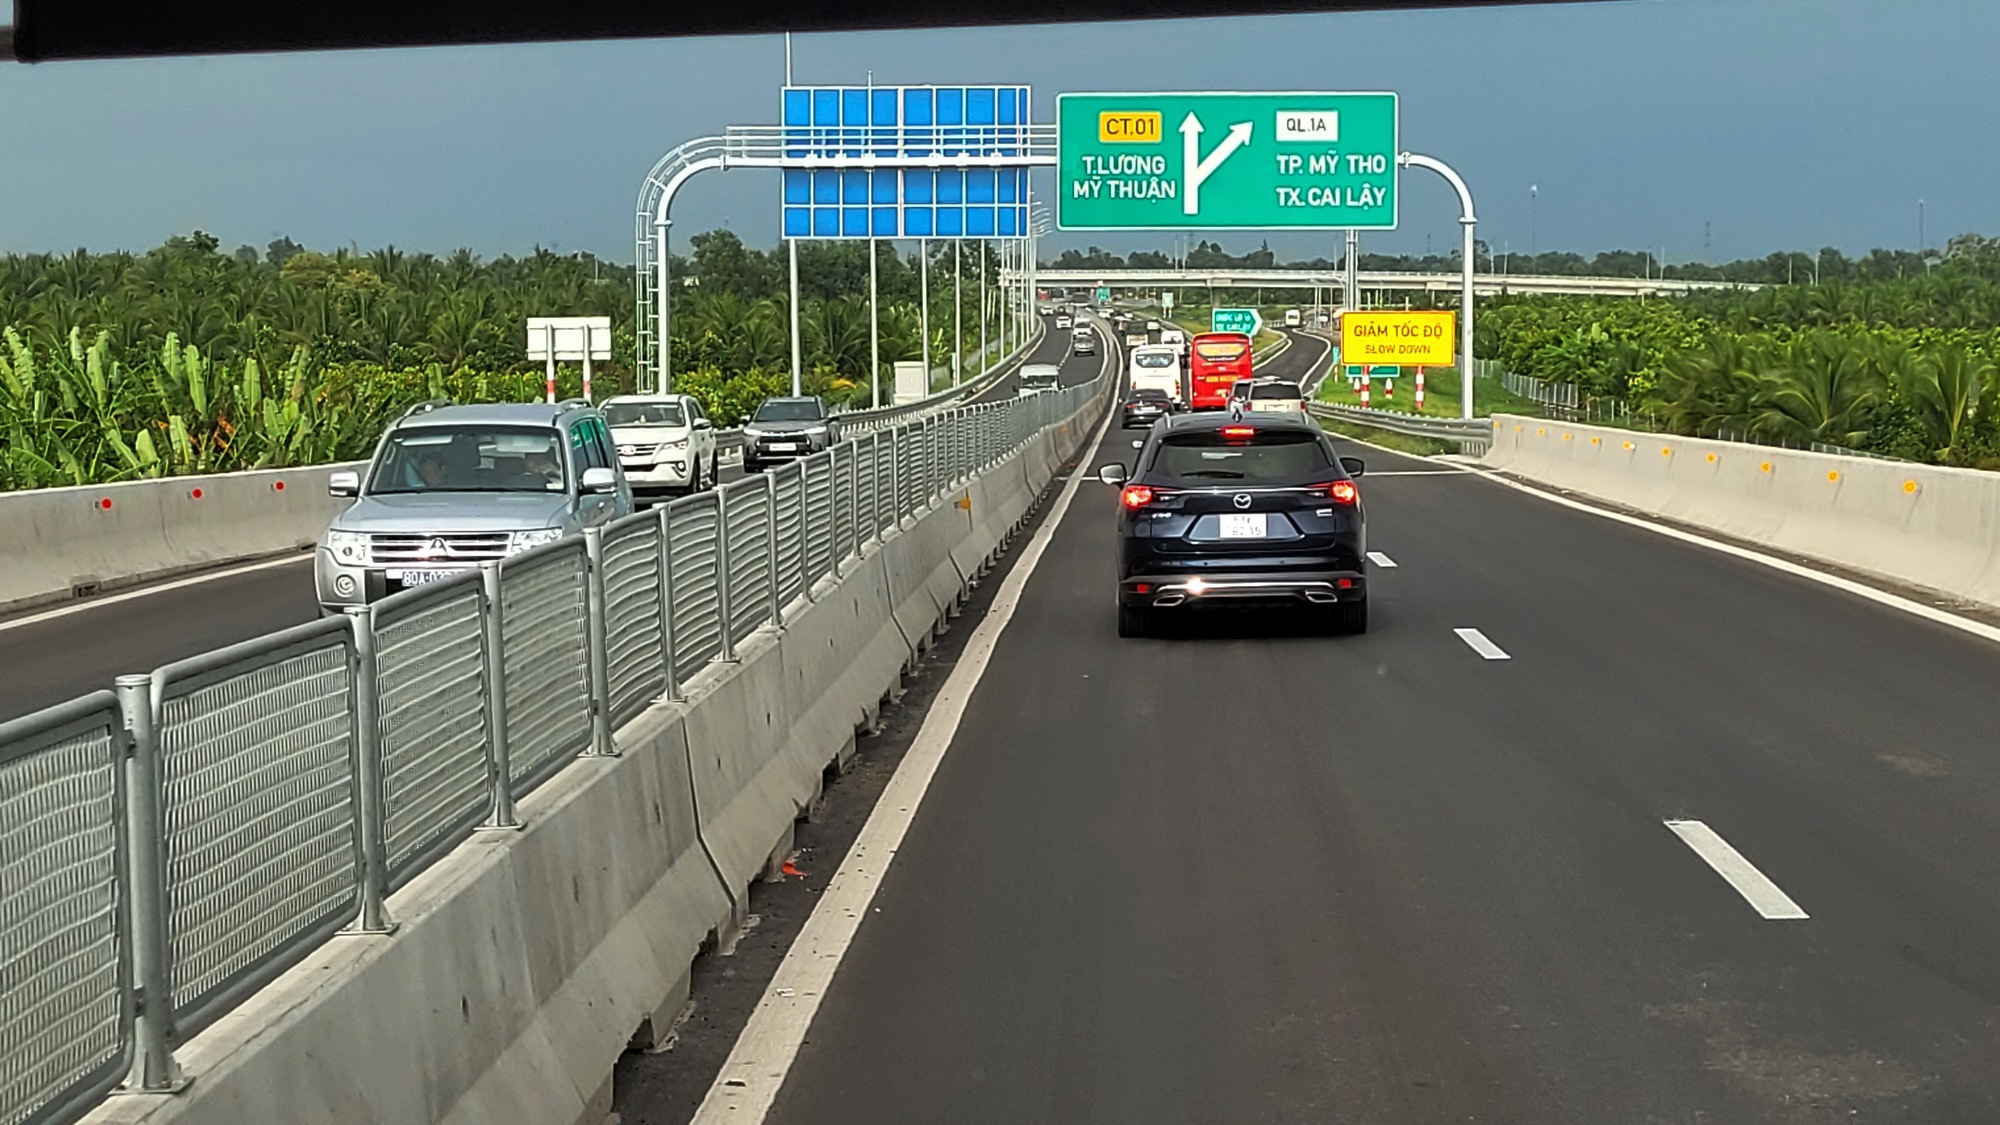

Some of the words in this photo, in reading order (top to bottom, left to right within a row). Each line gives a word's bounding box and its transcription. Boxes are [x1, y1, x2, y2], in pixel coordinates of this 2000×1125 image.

[1106, 118, 1154, 135] CT.01
[1286, 118, 1326, 132] QL.1A
[1082, 154, 1165, 174] T.LƯƠNG
[1276, 155, 1303, 174] TP.
[1309, 150, 1339, 174] MỸ
[1346, 155, 1386, 174] THO
[1073, 176, 1102, 198] MỸ
[1106, 177, 1176, 203] THUẬN
[1346, 183, 1386, 209] LẬY
[1354, 320, 1388, 337] GIẢM
[1393, 320, 1419, 337] TỐC
[1423, 322, 1443, 339] ĐỘ
[1365, 344, 1396, 354] SLOW
[1398, 344, 1431, 354] DOWN
